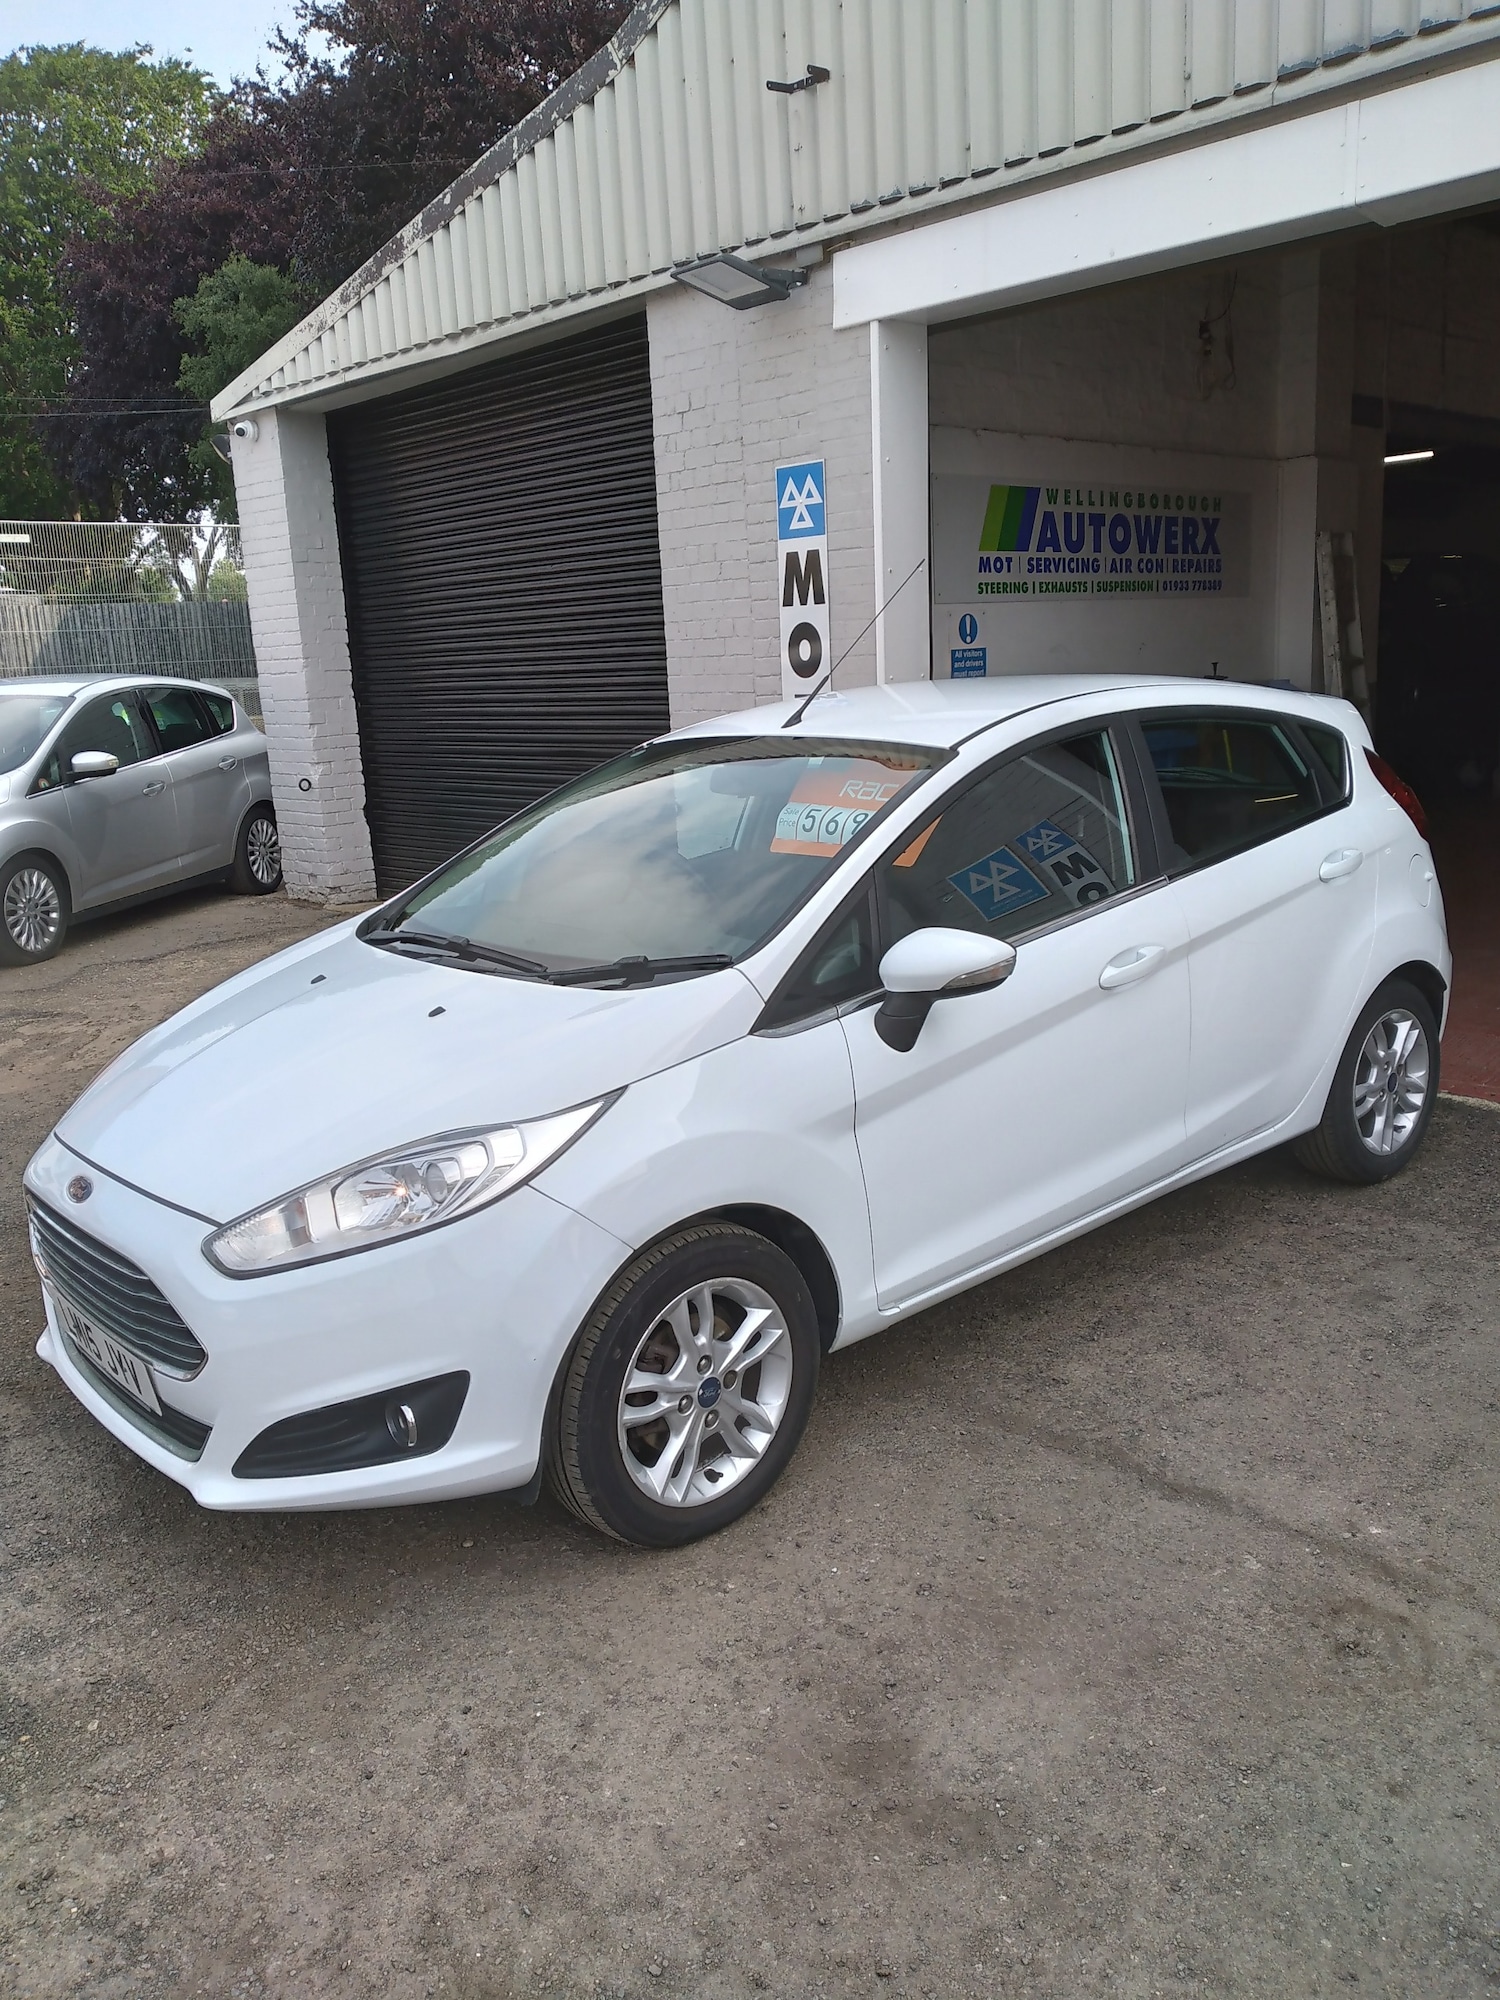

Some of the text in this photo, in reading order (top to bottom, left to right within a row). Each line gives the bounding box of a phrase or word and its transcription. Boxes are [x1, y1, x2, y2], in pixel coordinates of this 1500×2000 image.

[1046, 487, 1222, 511] WELLINGBOROUGH
[1036, 511, 1222, 555] AUTOWERX
[978, 556, 1222, 574] MOT SERVICING AIR CON REPAIRS
[977, 581, 1029, 595] STEERING
[1039, 581, 1088, 594] EXHAUSTS
[1096, 580, 1154, 593] SUSPENSION
[1162, 580, 1189, 592] 01933
[782, 549, 826, 697] MO
[963, 650, 983, 658] visitors
[954, 660, 984, 669] and drivers
[783, 807, 800, 816] Sale
[778, 817, 797, 828] Price
[104, 1339, 143, 1396] JYV
